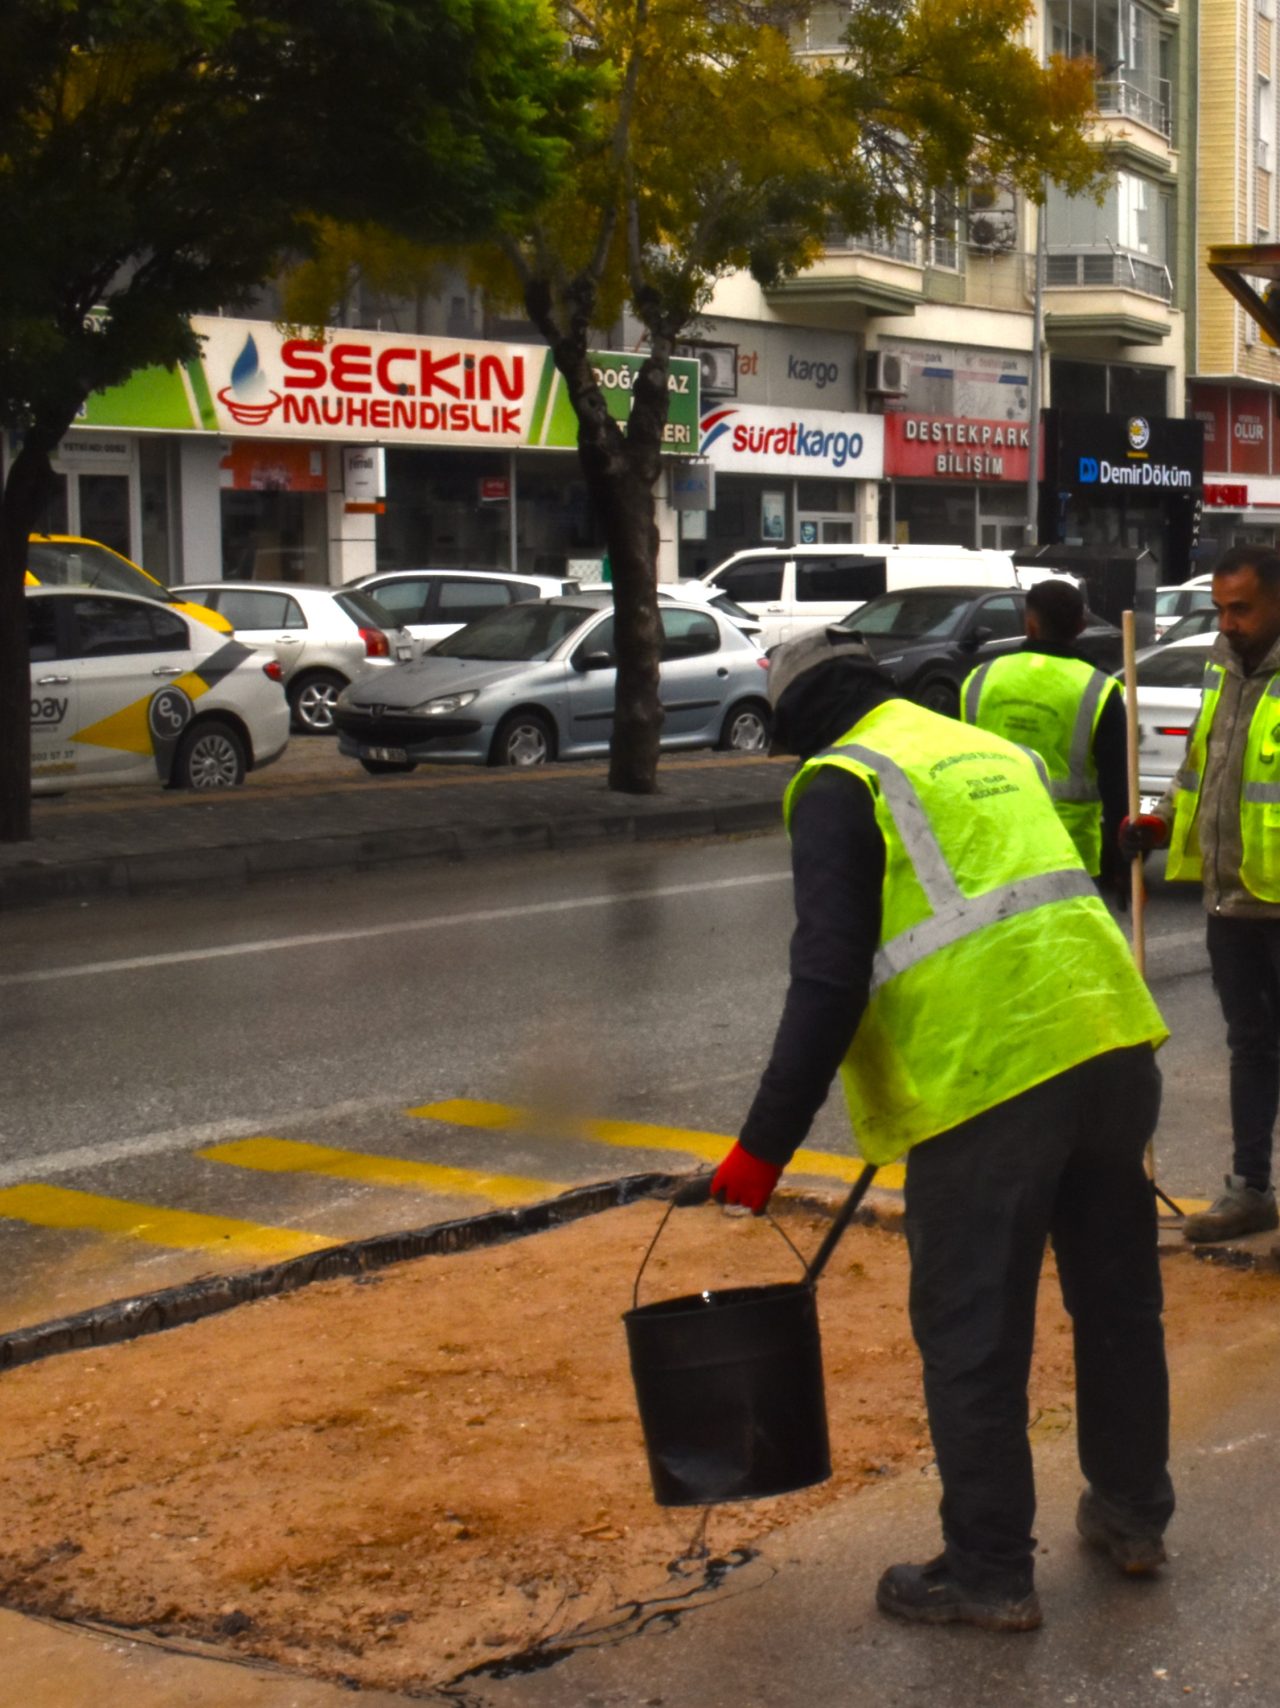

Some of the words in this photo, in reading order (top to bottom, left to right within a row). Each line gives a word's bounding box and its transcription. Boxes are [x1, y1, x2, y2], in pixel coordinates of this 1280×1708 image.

[787, 354, 839, 389] kargo
[906, 420, 1030, 447] DESTEKPARK
[1233, 422, 1264, 440] OLUR
[936, 449, 1004, 478] BİLİŞİM
[1100, 460, 1192, 487] DemirDöküm
